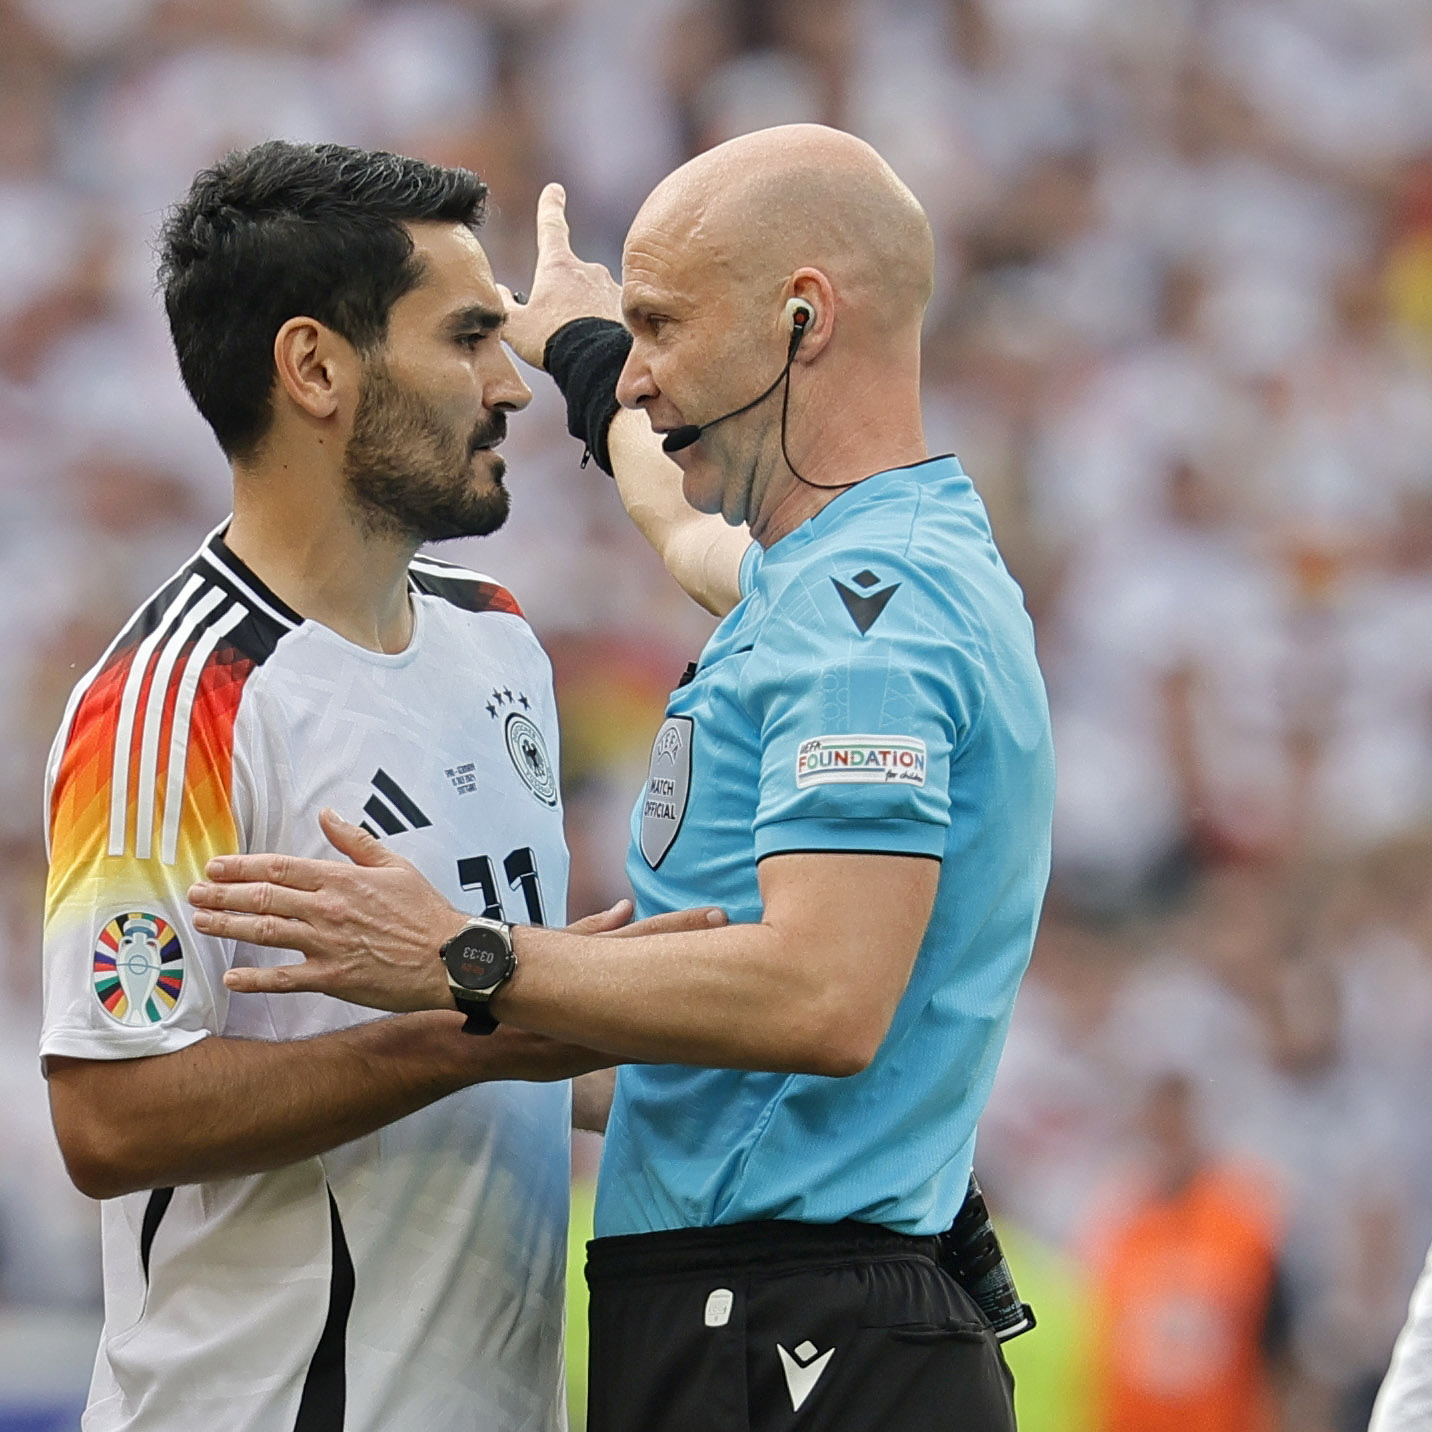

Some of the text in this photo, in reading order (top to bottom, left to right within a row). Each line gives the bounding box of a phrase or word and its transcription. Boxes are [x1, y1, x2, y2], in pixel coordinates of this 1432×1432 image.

[800, 740, 821, 755] UEFA
[798, 750, 925, 772] FOUNDATION
[650, 780, 674, 796] MATCH
[645, 802, 676, 820] OFFICIAL
